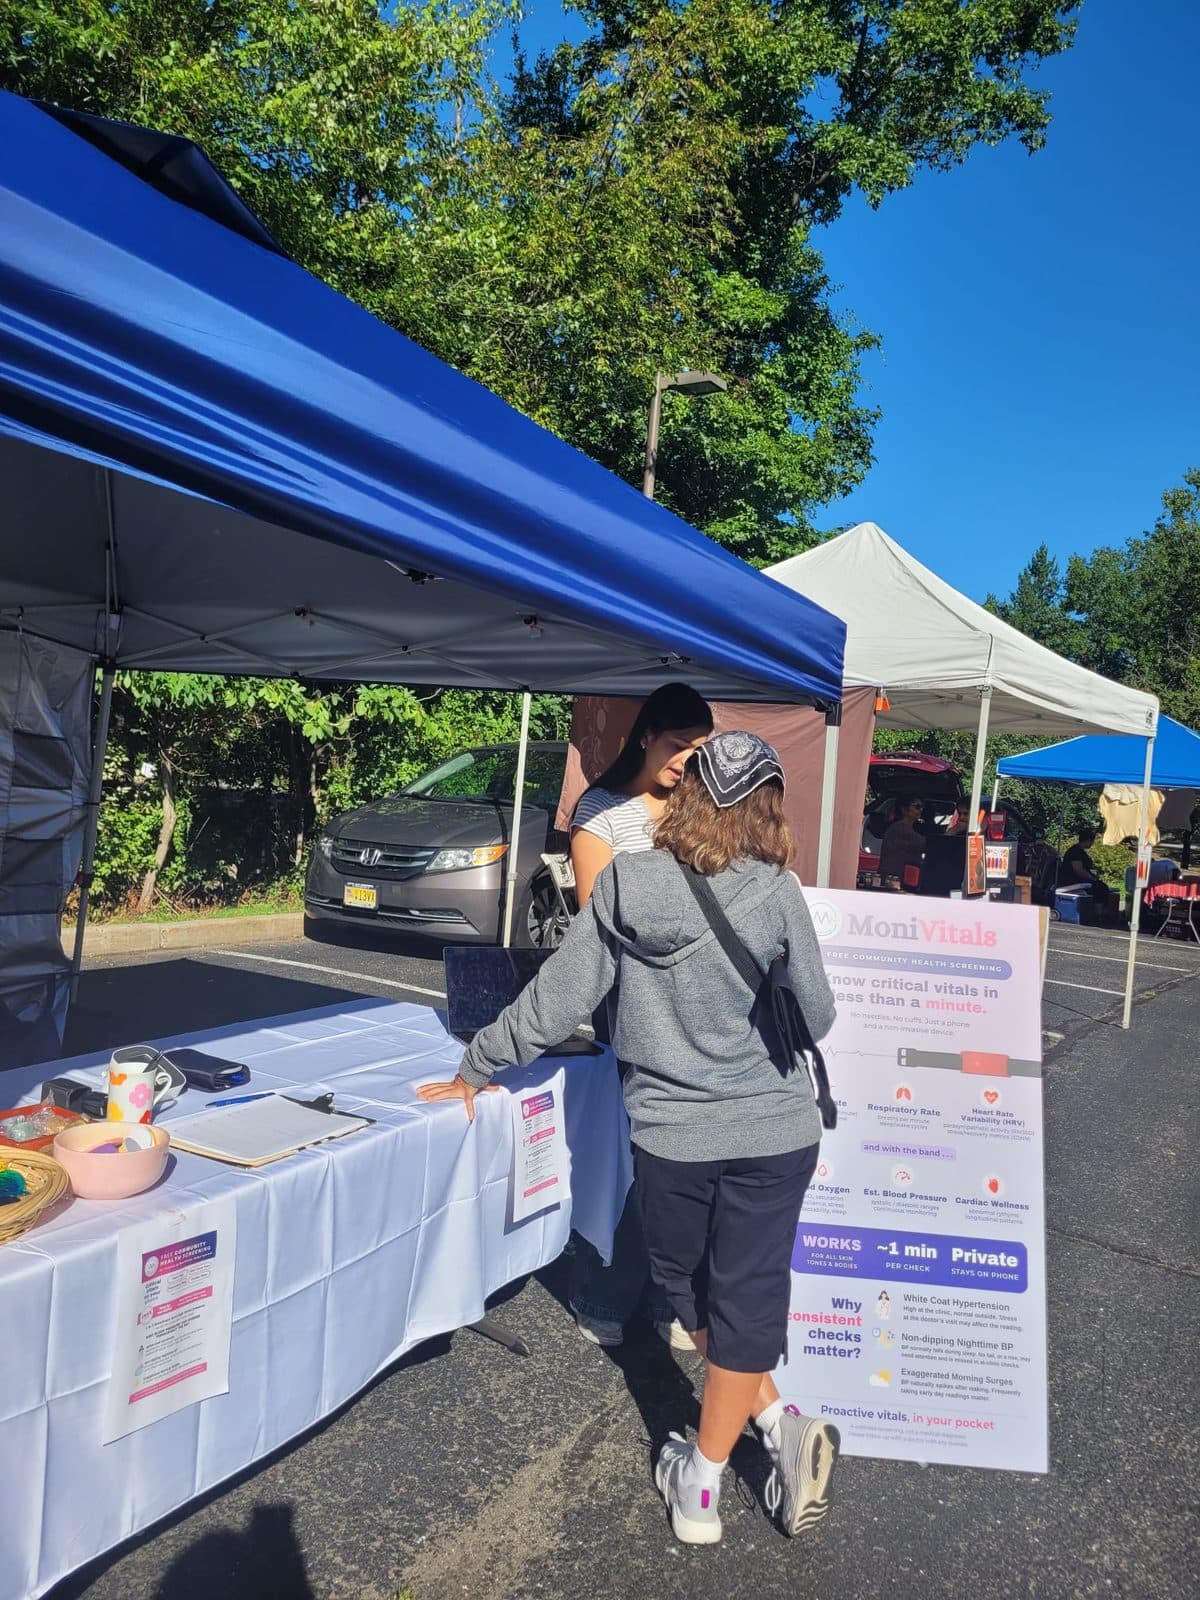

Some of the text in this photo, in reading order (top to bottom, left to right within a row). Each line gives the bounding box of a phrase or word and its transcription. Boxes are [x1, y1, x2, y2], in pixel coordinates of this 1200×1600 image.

[848, 912, 997, 947] MoniVitals
[827, 951, 1002, 972] FREE COMMUNITY HEALTH SCREENING
[871, 977, 928, 992] critical
[934, 982, 978, 997] vitals
[984, 986, 998, 998] in
[869, 992, 905, 1006] than
[910, 998, 920, 1008] a
[926, 999, 987, 1014] minute.
[864, 1022, 877, 1030] and
[947, 1020, 970, 1028] phone
[868, 1103, 918, 1115] Respiratory
[920, 1108, 941, 1117] Rate
[972, 1108, 1014, 1118] Heart Rate
[961, 1115, 1025, 1127] Variability (HRV)
[864, 1142, 879, 1151] and
[881, 1144, 901, 1153] with
[902, 1146, 917, 1155] the
[919, 1148, 940, 1157] band
[818, 1184, 850, 1195] Oxygen
[863, 1188, 948, 1203] Est. Blood Pressure
[955, 1197, 1029, 1210] Cardiac Wellness
[174, 1241, 207, 1256] COMMUNITY
[802, 1234, 862, 1251] WORKS
[877, 1241, 938, 1259] ~1 min
[160, 1255, 182, 1266] HEALTH
[182, 1245, 212, 1259] SCREENING
[951, 1247, 1018, 1268] Private
[807, 1259, 827, 1267] TONES
[834, 1262, 858, 1270] BODIES
[886, 1262, 931, 1273] PER CHECK
[951, 1268, 975, 1277] STAYS
[991, 1272, 1020, 1281] PHONE
[831, 1297, 862, 1314] Why
[903, 1294, 1010, 1312] White Coat Hypertension
[959, 1320, 971, 1328] may
[972, 1320, 988, 1328] affect
[808, 1328, 862, 1342] checks
[901, 1333, 1014, 1351] Non-dipping Nighttime BP
[803, 1343, 861, 1359] matter?
[910, 1345, 932, 1353] normally
[944, 1348, 962, 1357] during
[915, 1353, 937, 1361] attention
[901, 1368, 1013, 1386] Exaggerated Morning Surges
[900, 1388, 918, 1396] taking
[919, 1390, 933, 1398] early
[934, 1391, 944, 1399] day
[945, 1392, 970, 1401] readings
[910, 1380, 935, 1388] naturally
[936, 1382, 954, 1390] spikes
[991, 1387, 1021, 1397] Frequently
[821, 1405, 995, 1430] Proactive vitals, in your pocket
